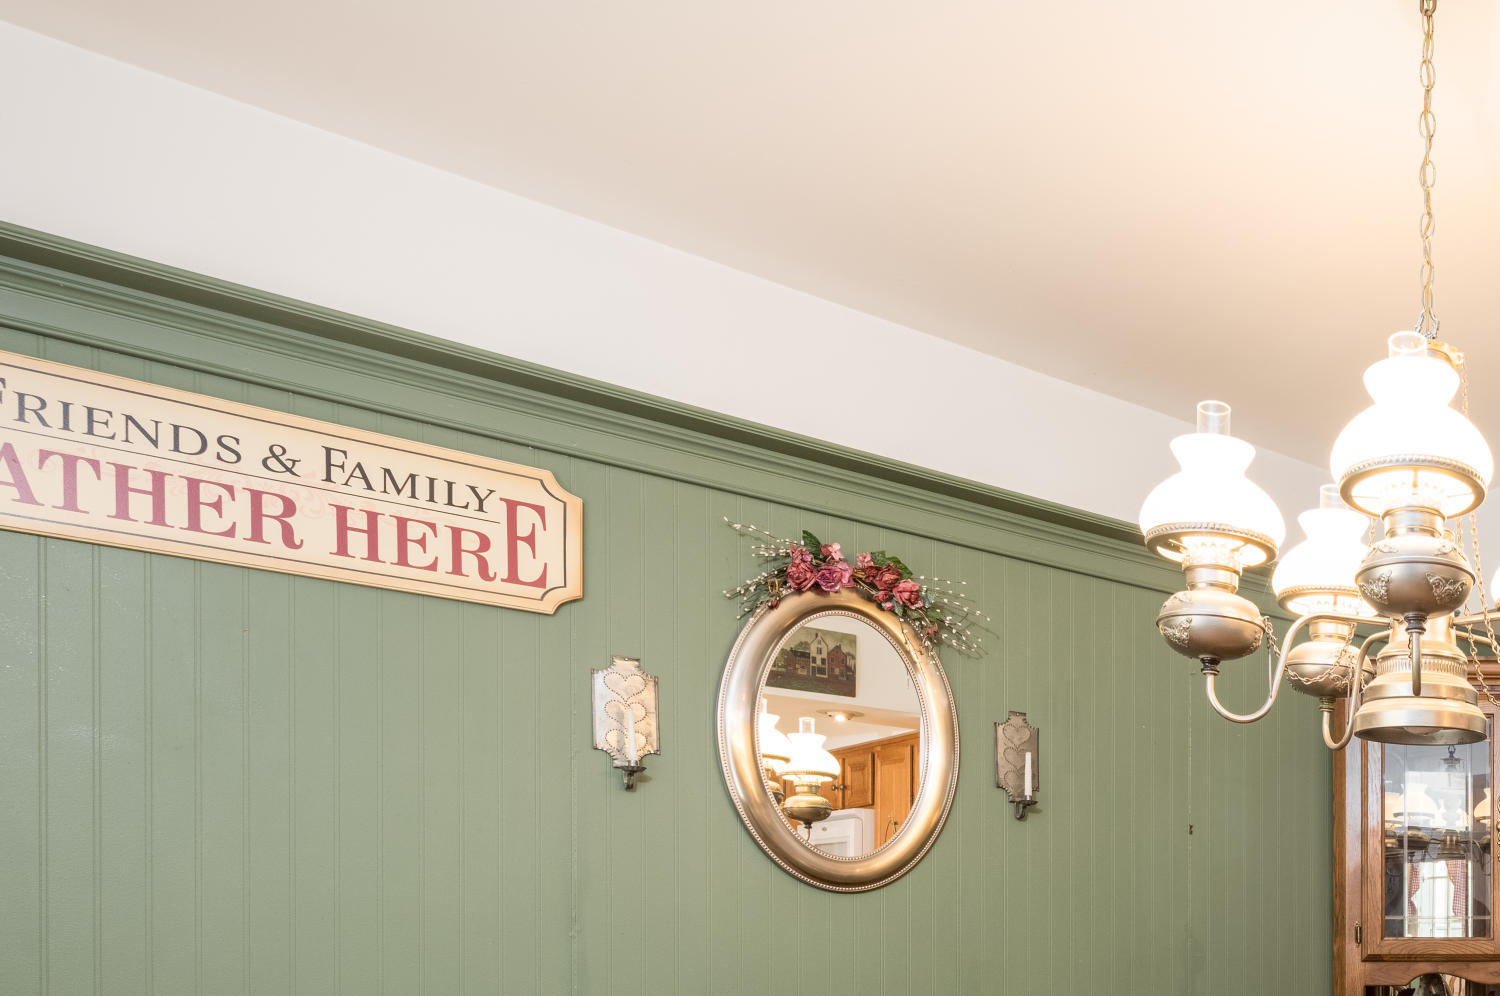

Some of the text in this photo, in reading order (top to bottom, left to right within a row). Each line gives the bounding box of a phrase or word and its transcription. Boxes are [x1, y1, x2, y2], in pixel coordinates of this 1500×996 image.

[0, 377, 497, 514] RIENDS & FAMILY
[0, 442, 548, 589] ATHER HERE
